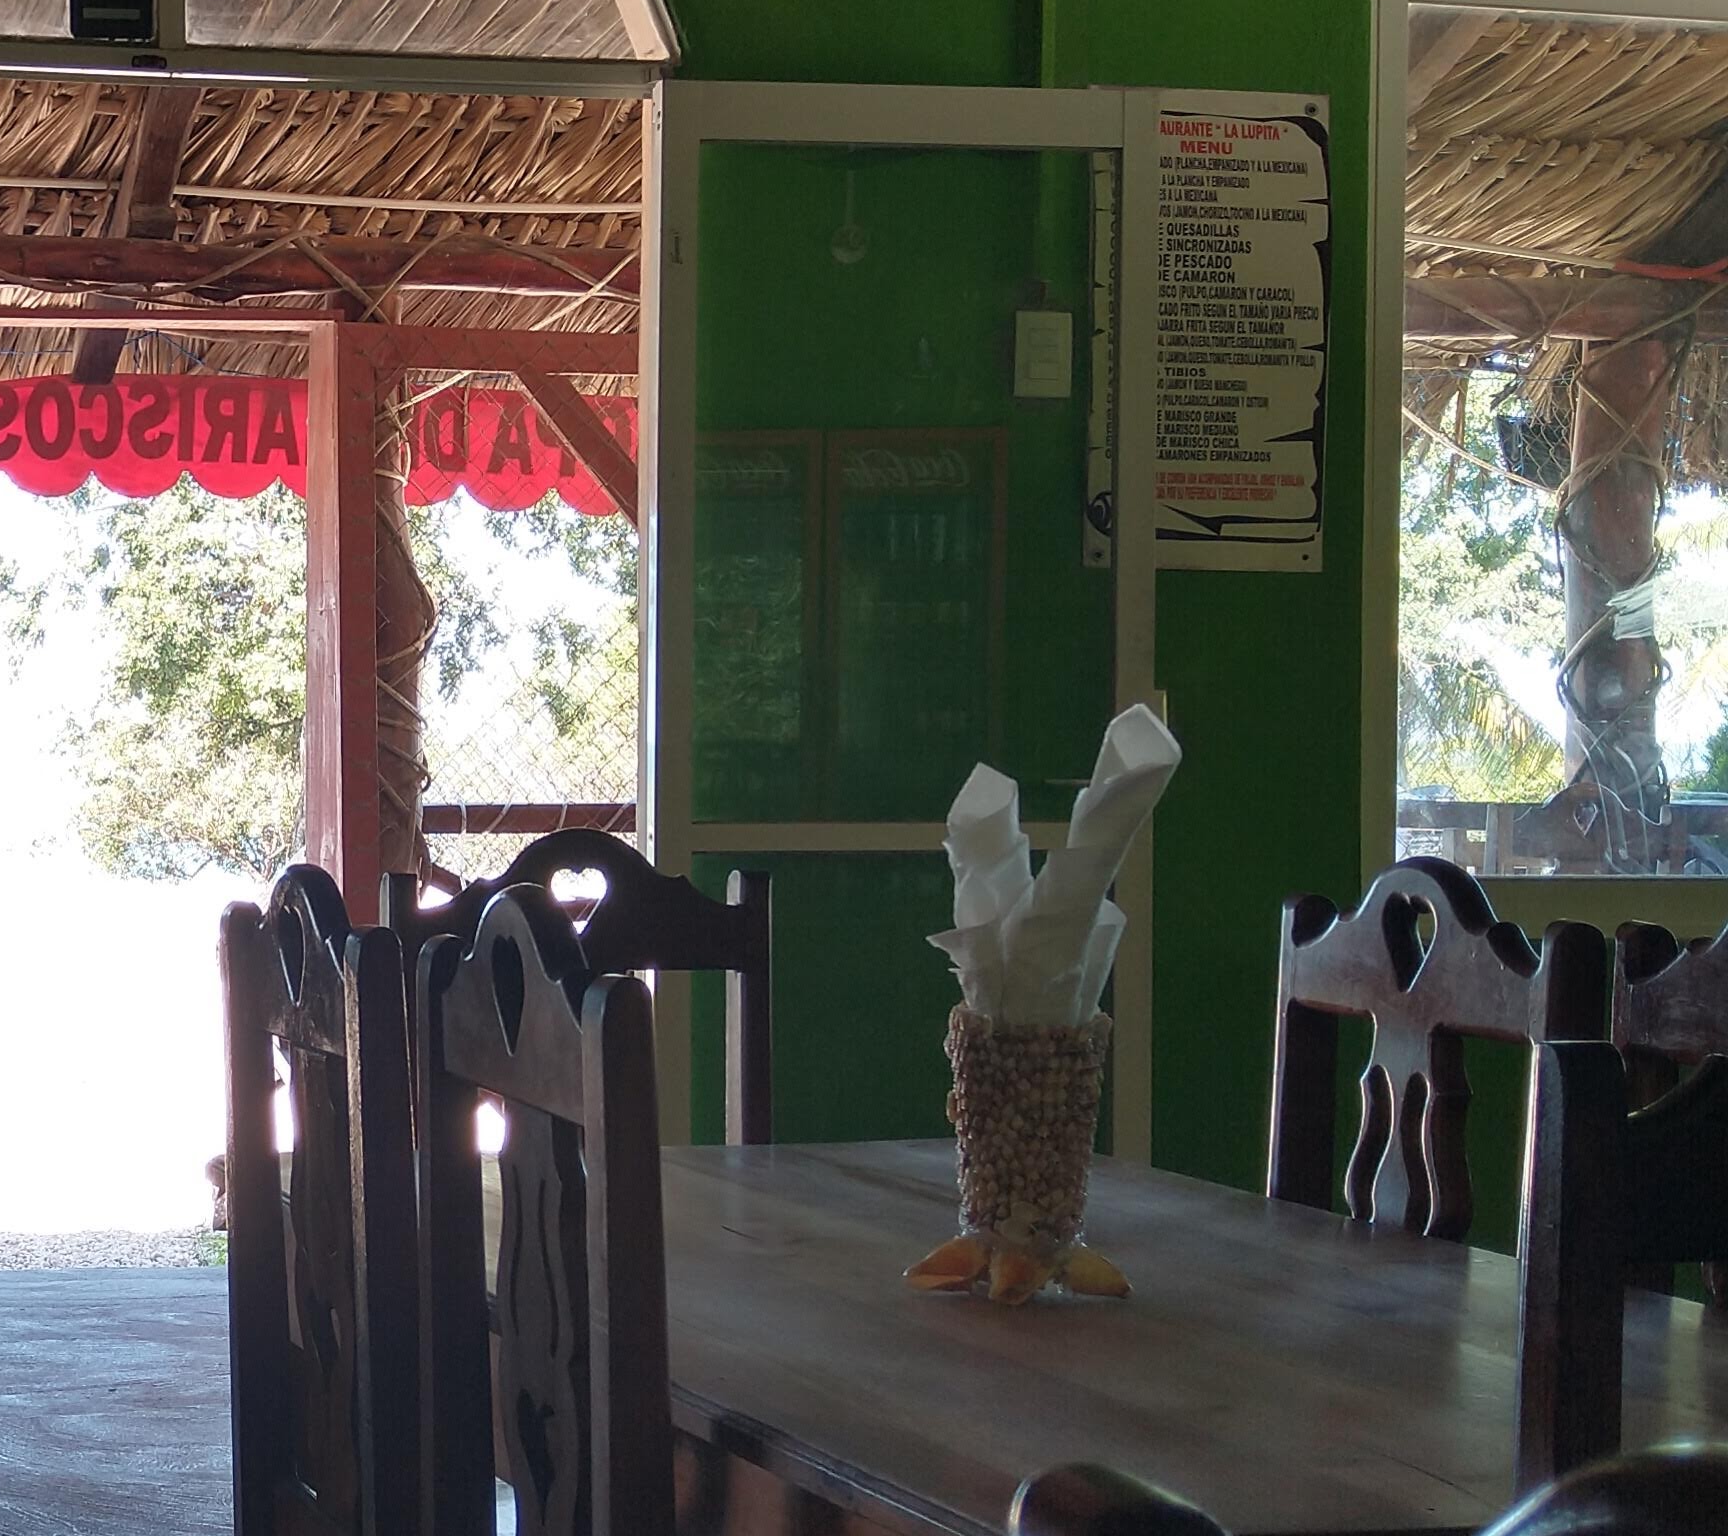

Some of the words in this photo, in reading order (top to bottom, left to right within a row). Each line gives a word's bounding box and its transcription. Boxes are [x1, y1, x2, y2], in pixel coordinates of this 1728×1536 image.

[1159, 120, 1212, 138] AURANTE
[1224, 123, 1238, 138] LA
[1241, 124, 1280, 140] LUPITA
[1180, 140, 1233, 155] MENU
[1262, 160, 1271, 173] LA
[1167, 174, 1175, 186] LA
[1175, 174, 1205, 187] PLANCHA
[1167, 189, 1173, 202] A
[1174, 189, 1183, 202] LA
[1183, 189, 1218, 203] MEXICANA
[1255, 207, 1261, 221] A
[1261, 207, 1270, 222] LA
[1166, 221, 1240, 238] QUESADILLAS
[1165, 238, 1252, 254] SINCRONIZADAS
[1174, 254, 1233, 269] PESCADO
[1173, 270, 1236, 284] CAMARON
[1158, 284, 1177, 298] ISCO
[1249, 287, 1255, 300] Y
[1158, 302, 1178, 317] CADO
[1202, 303, 1227, 318] SEGUN
[1228, 303, 1237, 318] EL
[1292, 305, 1319, 321] PRECIO
[1186, 319, 1207, 333] FRITA
[1208, 320, 1235, 334] SEGUN
[1236, 320, 1246, 334] EL
[1164, 367, 1207, 377] TIBIOS
[1157, 409, 1163, 422] E
[1164, 410, 1202, 423] MARISCO
[1203, 411, 1238, 424] GRANDE
[1156, 423, 1162, 435] E
[1164, 423, 1200, 436] MARISCO
[1202, 424, 1239, 437] MEDIANO
[1169, 436, 1210, 449] MARISCO
[1212, 437, 1240, 449] CHICA
[1155, 449, 1208, 462] AMARONES
[1210, 450, 1272, 463] EMPANIZADOS
